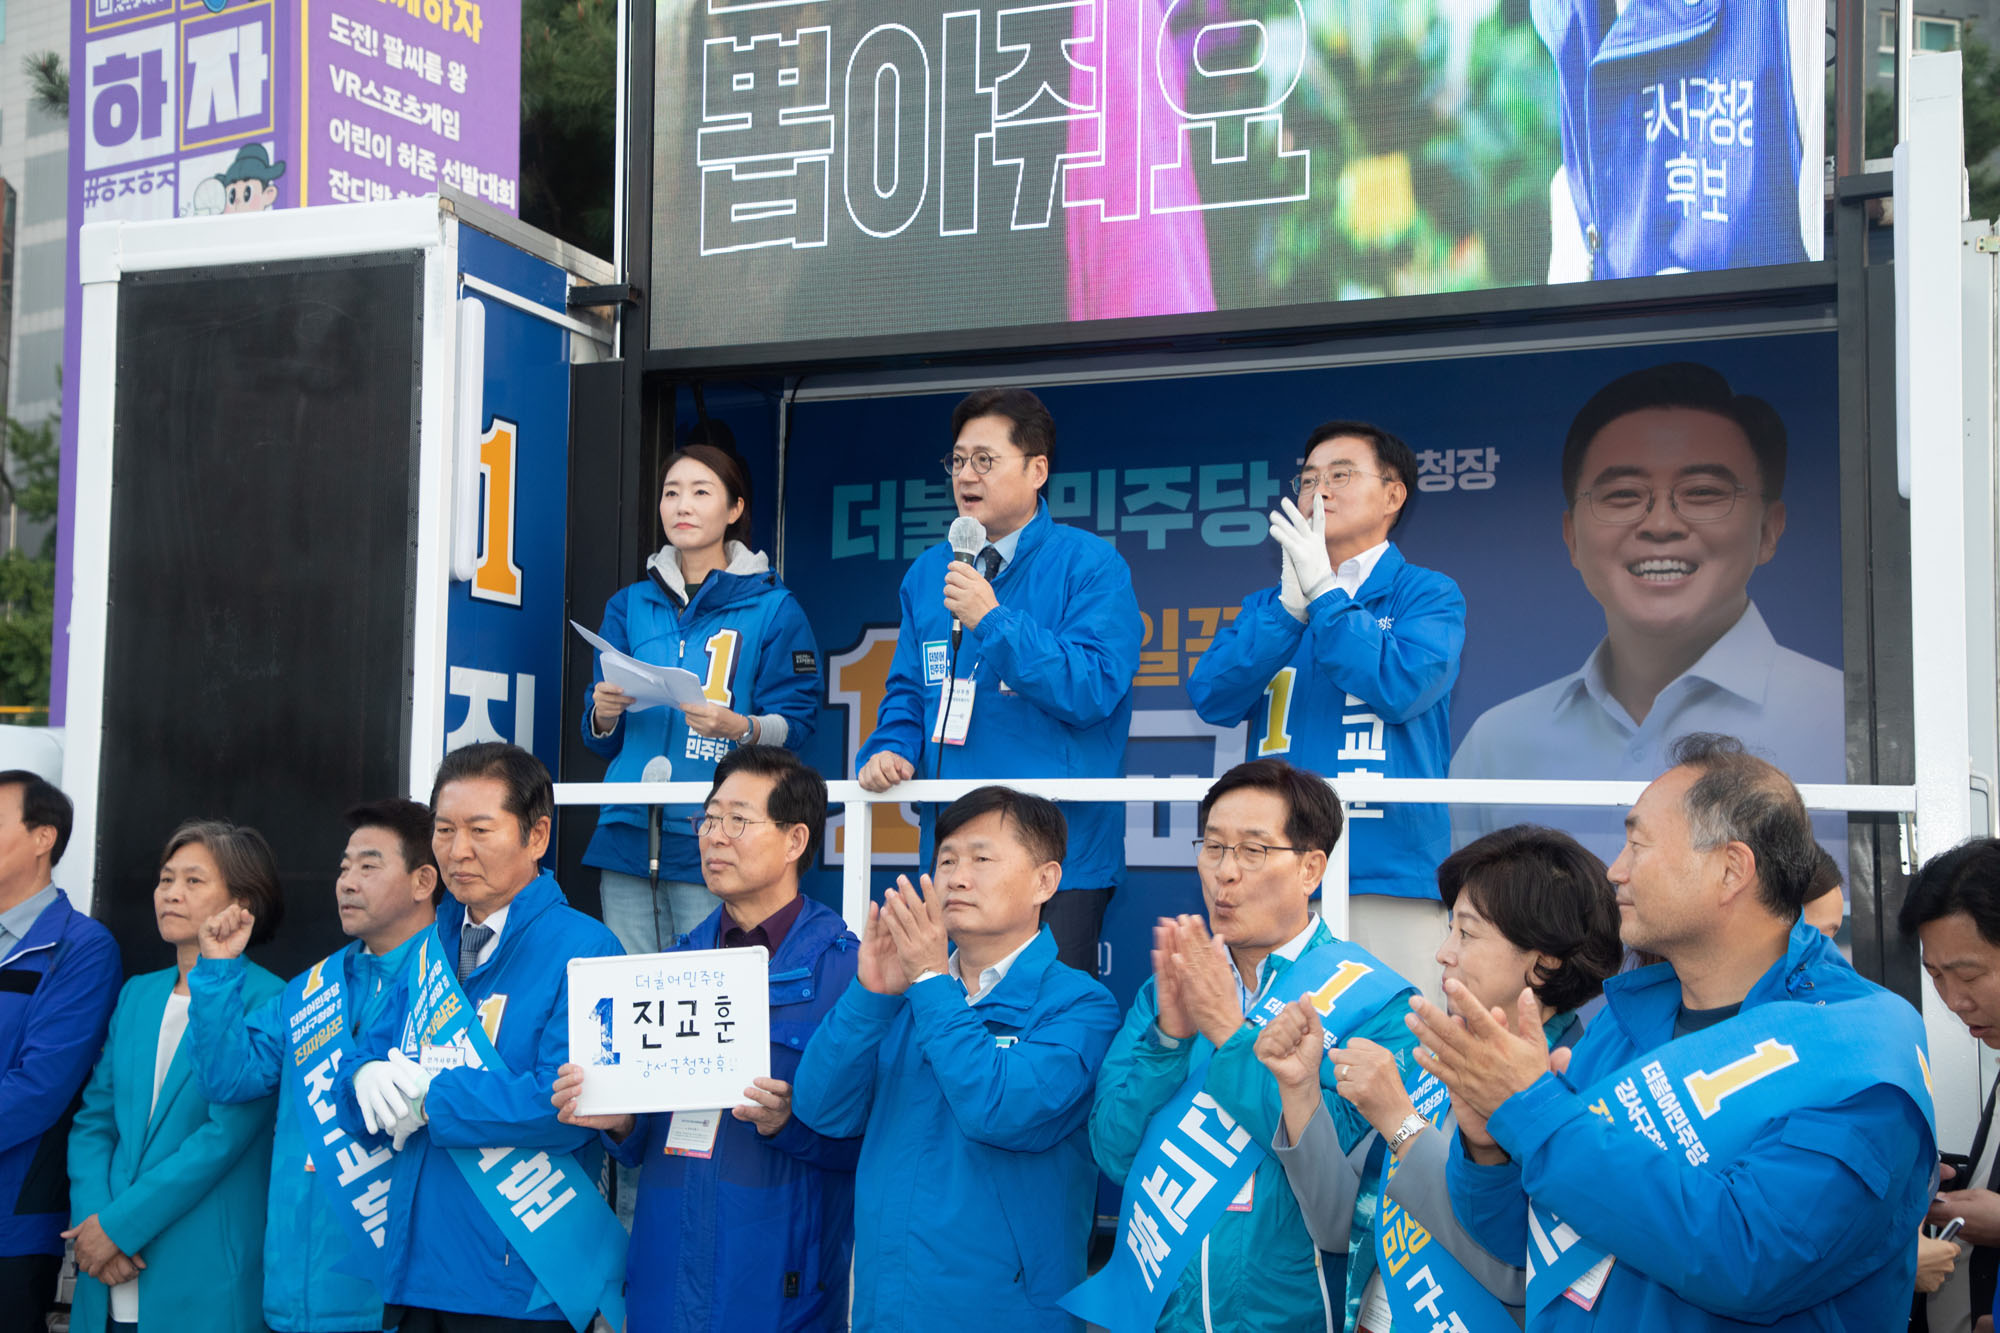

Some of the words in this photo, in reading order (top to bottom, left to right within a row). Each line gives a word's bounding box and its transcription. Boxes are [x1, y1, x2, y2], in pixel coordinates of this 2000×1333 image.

[328, 13, 378, 57] 도전!
[383, 34, 443, 86] 팔씨름
[447, 61, 467, 94] 왕
[329, 64, 460, 141] VR스포츠게임
[697, 0, 1310, 257] 뽑아줘요
[329, 118, 392, 166] 어린이
[397, 142, 438, 182] 허준
[441, 158, 515, 210] 선발대회
[1665, 151, 1728, 222] 후보
[471, 418, 522, 606] 1
[831, 460, 1280, 560] 더불민주당
[701, 629, 742, 708] 1
[1258, 667, 1297, 757] 1
[477, 993, 508, 1048] 1
[635, 970, 727, 990] 더불어민주당
[1305, 960, 1374, 1018] 1
[588, 997, 621, 1066] 1
[632, 995, 736, 1050] 진교훈
[1641, 1060, 1710, 1167] 더불어민주당
[1683, 1038, 1800, 1120] 1
